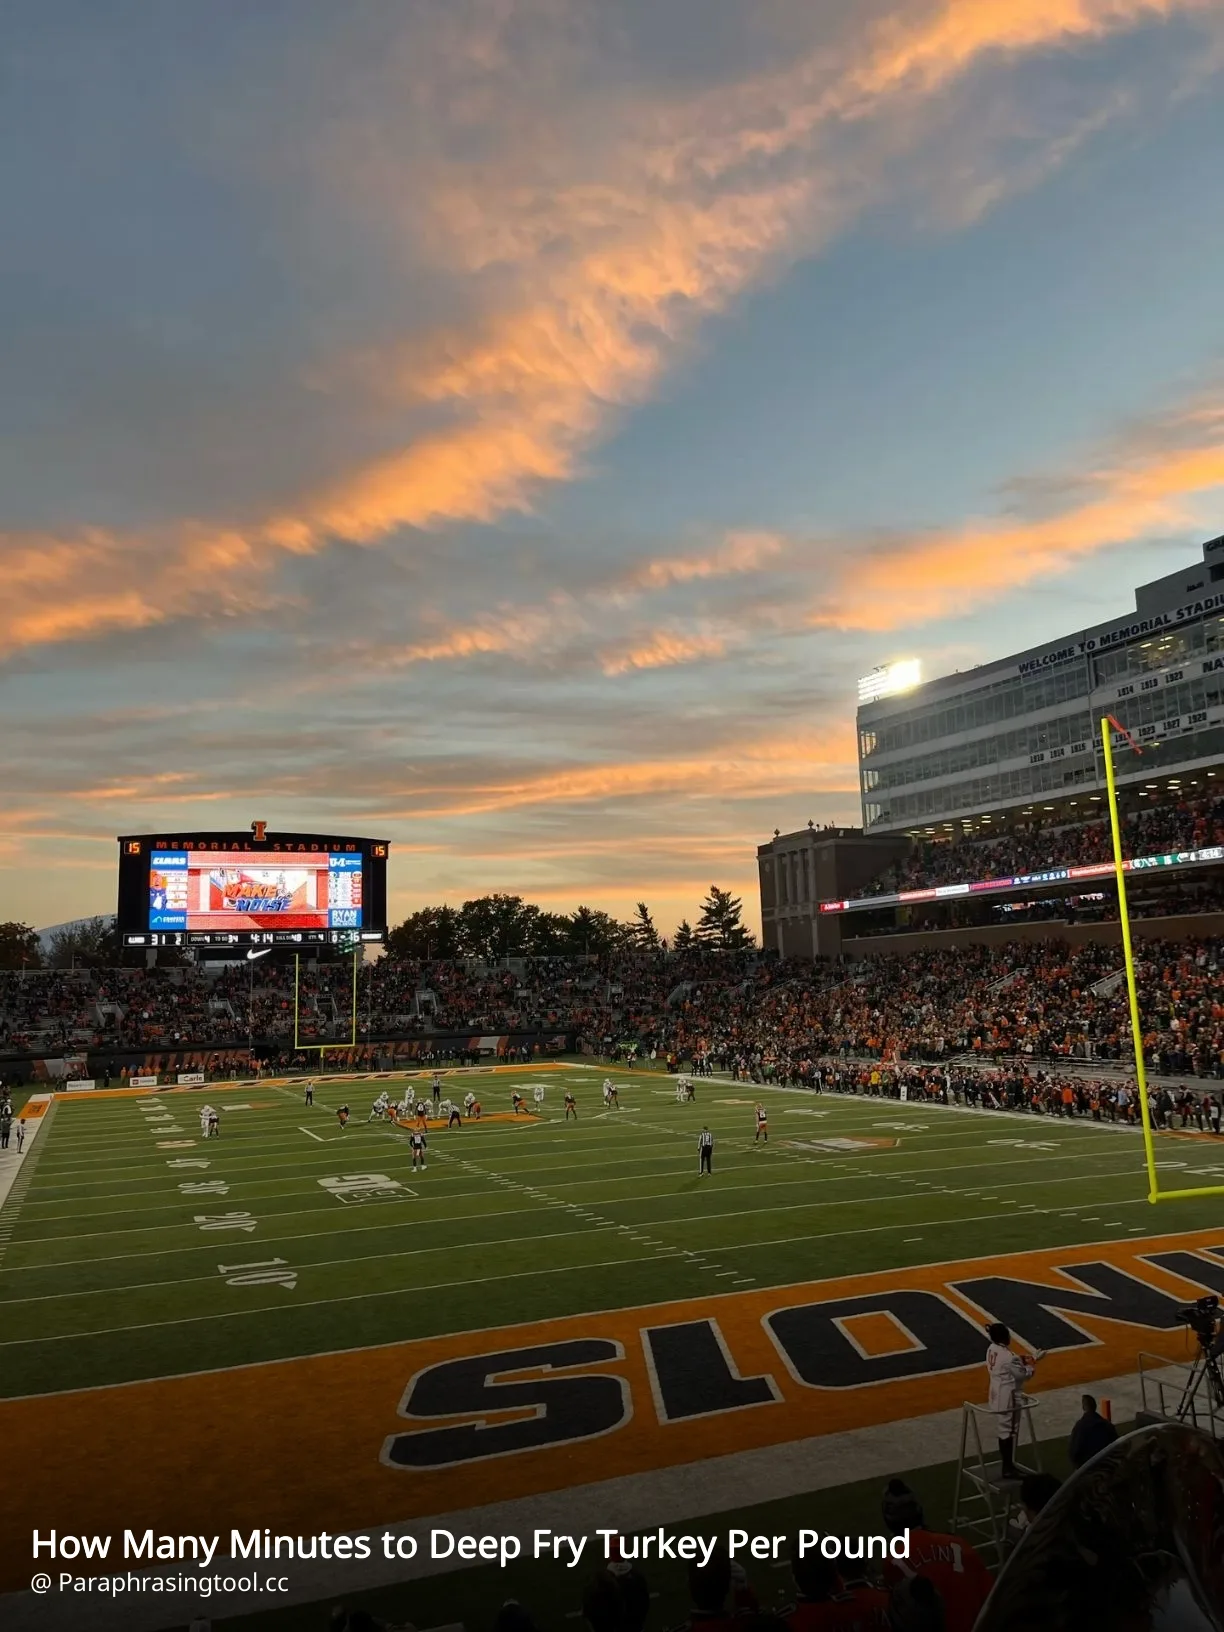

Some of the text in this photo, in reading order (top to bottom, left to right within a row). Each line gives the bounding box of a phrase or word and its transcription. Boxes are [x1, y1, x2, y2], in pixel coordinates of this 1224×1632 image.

[1019, 647, 1075, 673] WELCOME
[1078, 641, 1096, 653] TO
[1100, 614, 1171, 646] MEMORIAL
[1117, 685, 1134, 697] 1914
[1165, 671, 1184, 683] 1923
[129, 842, 140, 854] 15
[156, 841, 356, 852] MEMORIAL STADIUM
[374, 846, 386, 857] 15
[221, 882, 278, 898] MAKE
[235, 897, 290, 911] NOISE
[250, 933, 273, 944] 4:14
[193, 1210, 258, 1231] 20
[217, 1257, 298, 1288] 10
